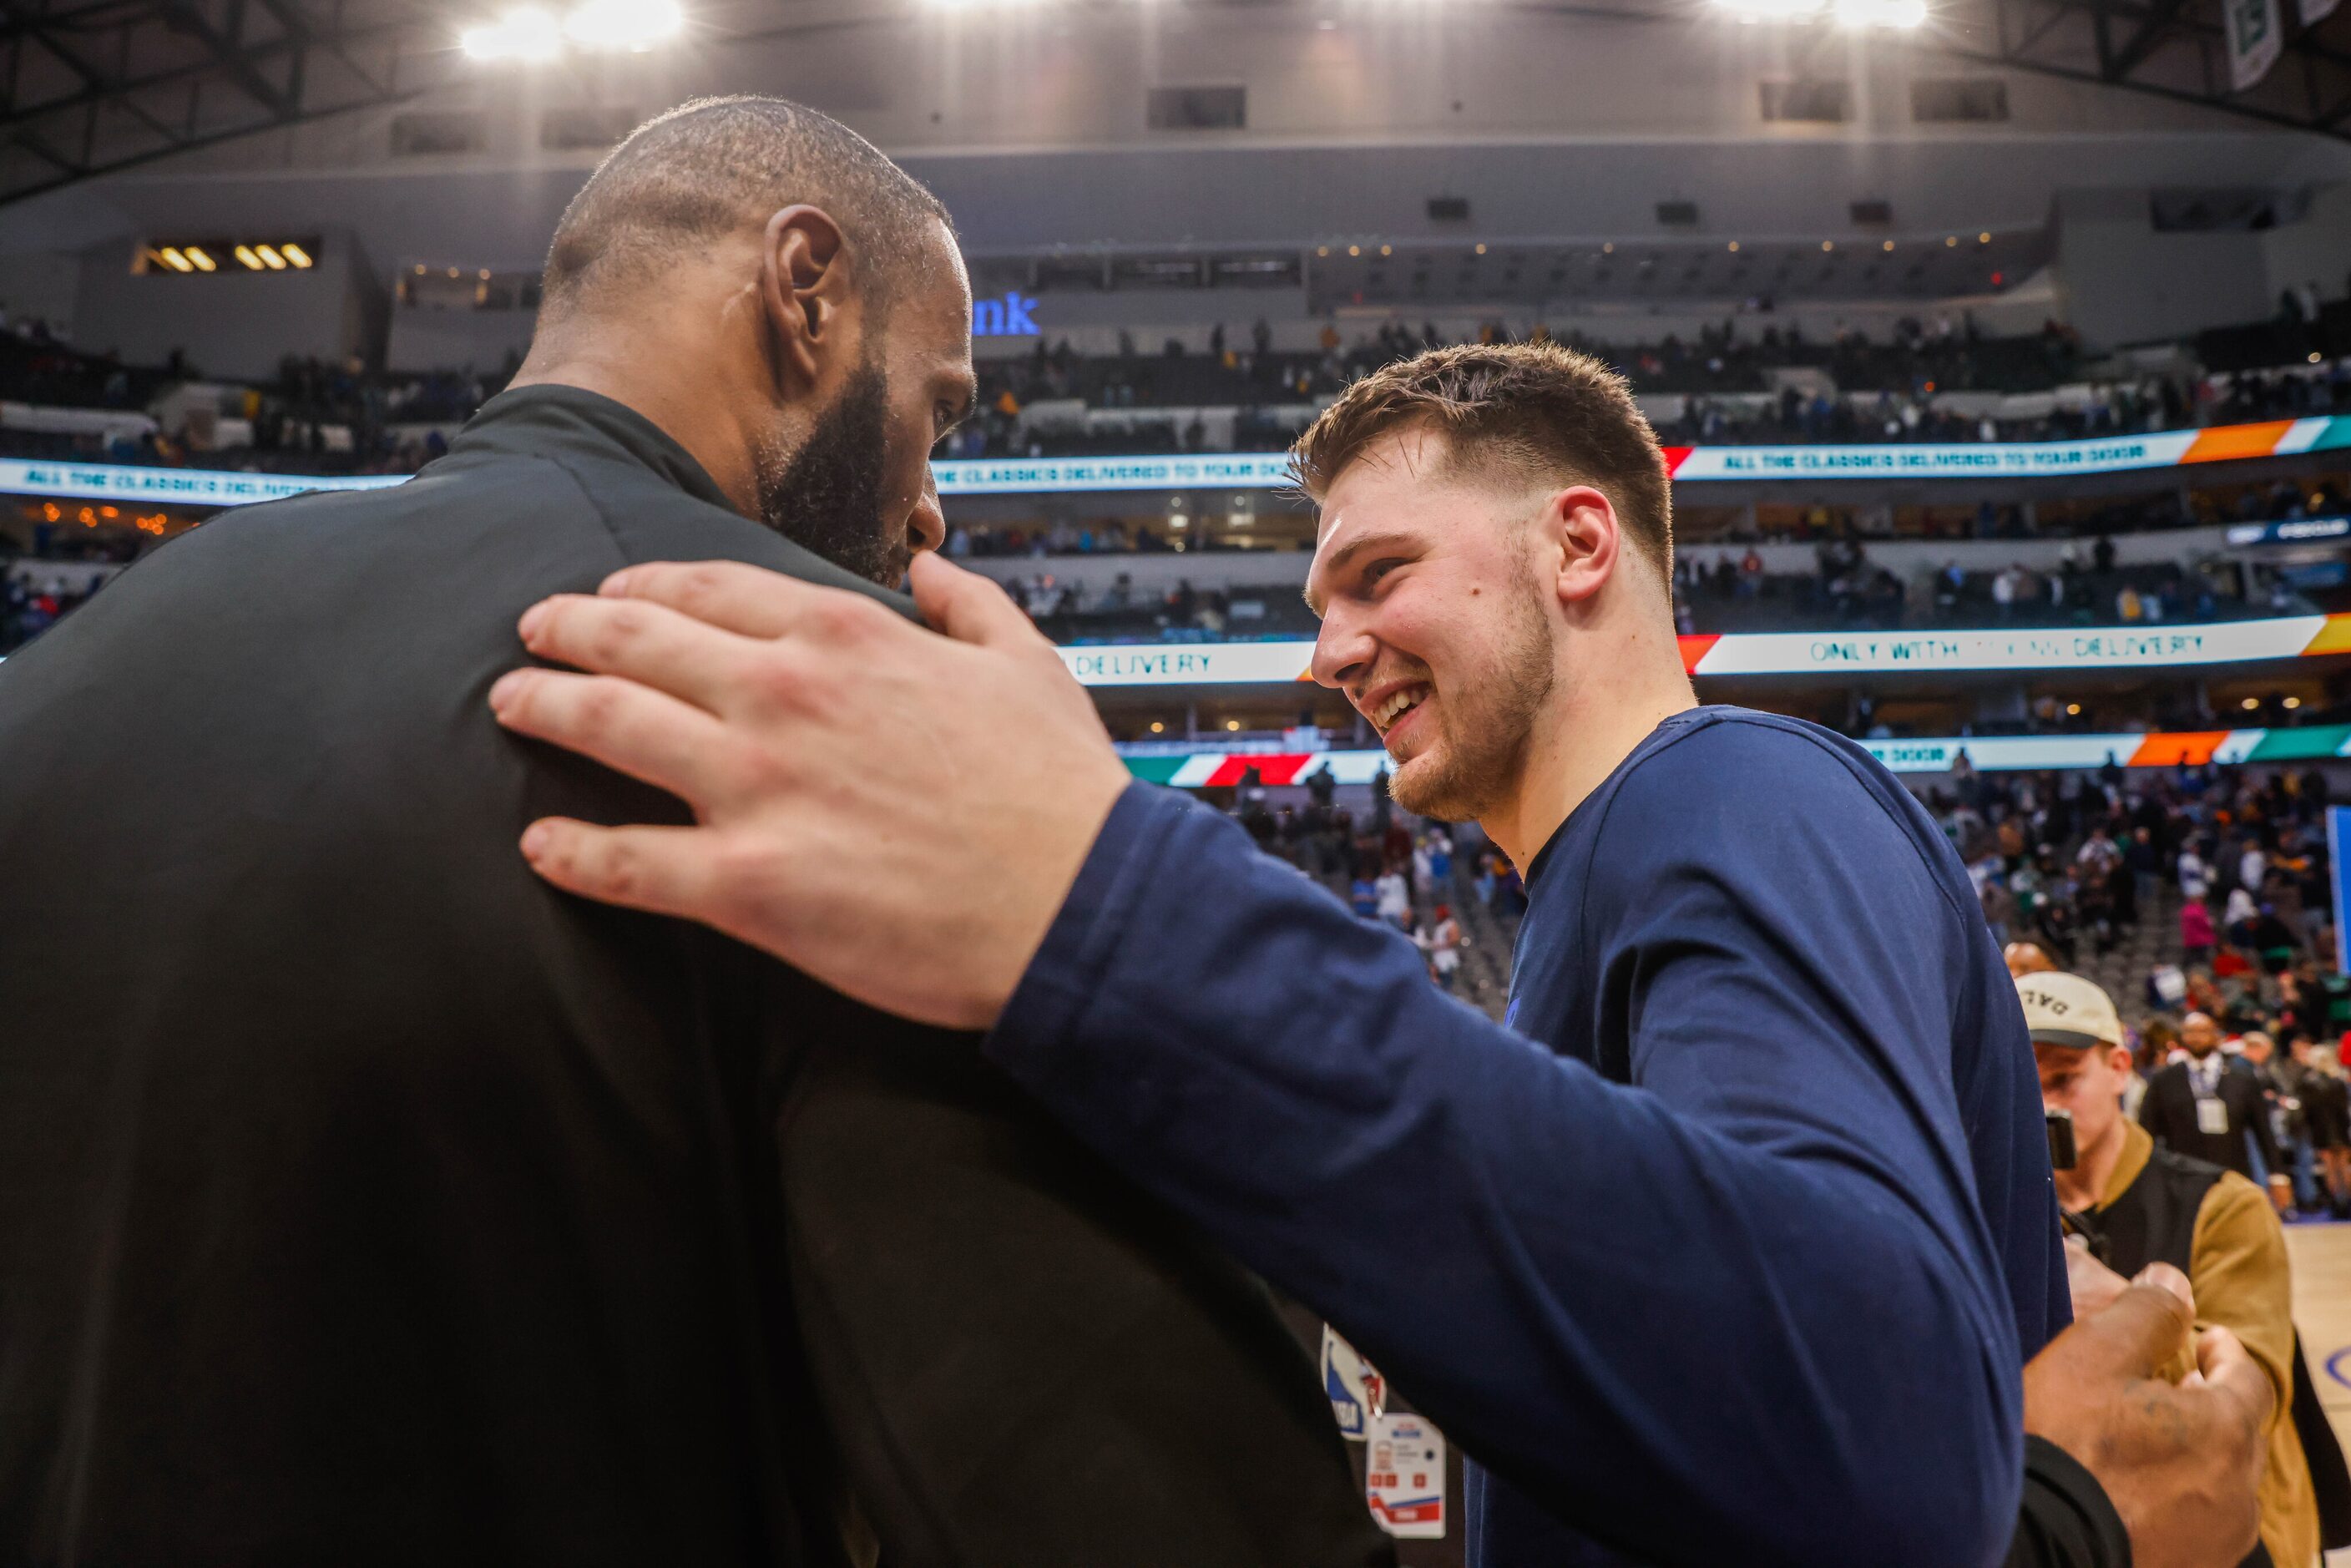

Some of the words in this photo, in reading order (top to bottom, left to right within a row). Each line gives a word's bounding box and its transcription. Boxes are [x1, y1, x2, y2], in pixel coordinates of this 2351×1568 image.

[1724, 456, 1755, 469] ALL
[1763, 455, 1795, 469] THE
[1802, 454, 1893, 468] CLASSICS
[1899, 453, 1998, 468] DELIVERED
[2005, 452, 2025, 466] TO
[2034, 449, 2082, 465] YOUR
[2089, 445, 2143, 463] DOOR
[26, 470, 60, 485] ALL
[71, 472, 107, 487] THE
[117, 474, 217, 492] CLASSICS
[963, 468, 1058, 483] CLASSICS
[1064, 465, 1168, 482] DELIVERED
[1175, 463, 1198, 478] TO
[1205, 462, 1253, 477] YOUR
[1810, 641, 1877, 662] ONLY
[1889, 640, 1959, 660] WITH
[2073, 635, 2204, 657] DELIVERY
[1076, 654, 1212, 675] DELIVERY
[1892, 747, 1944, 762] DOOR
